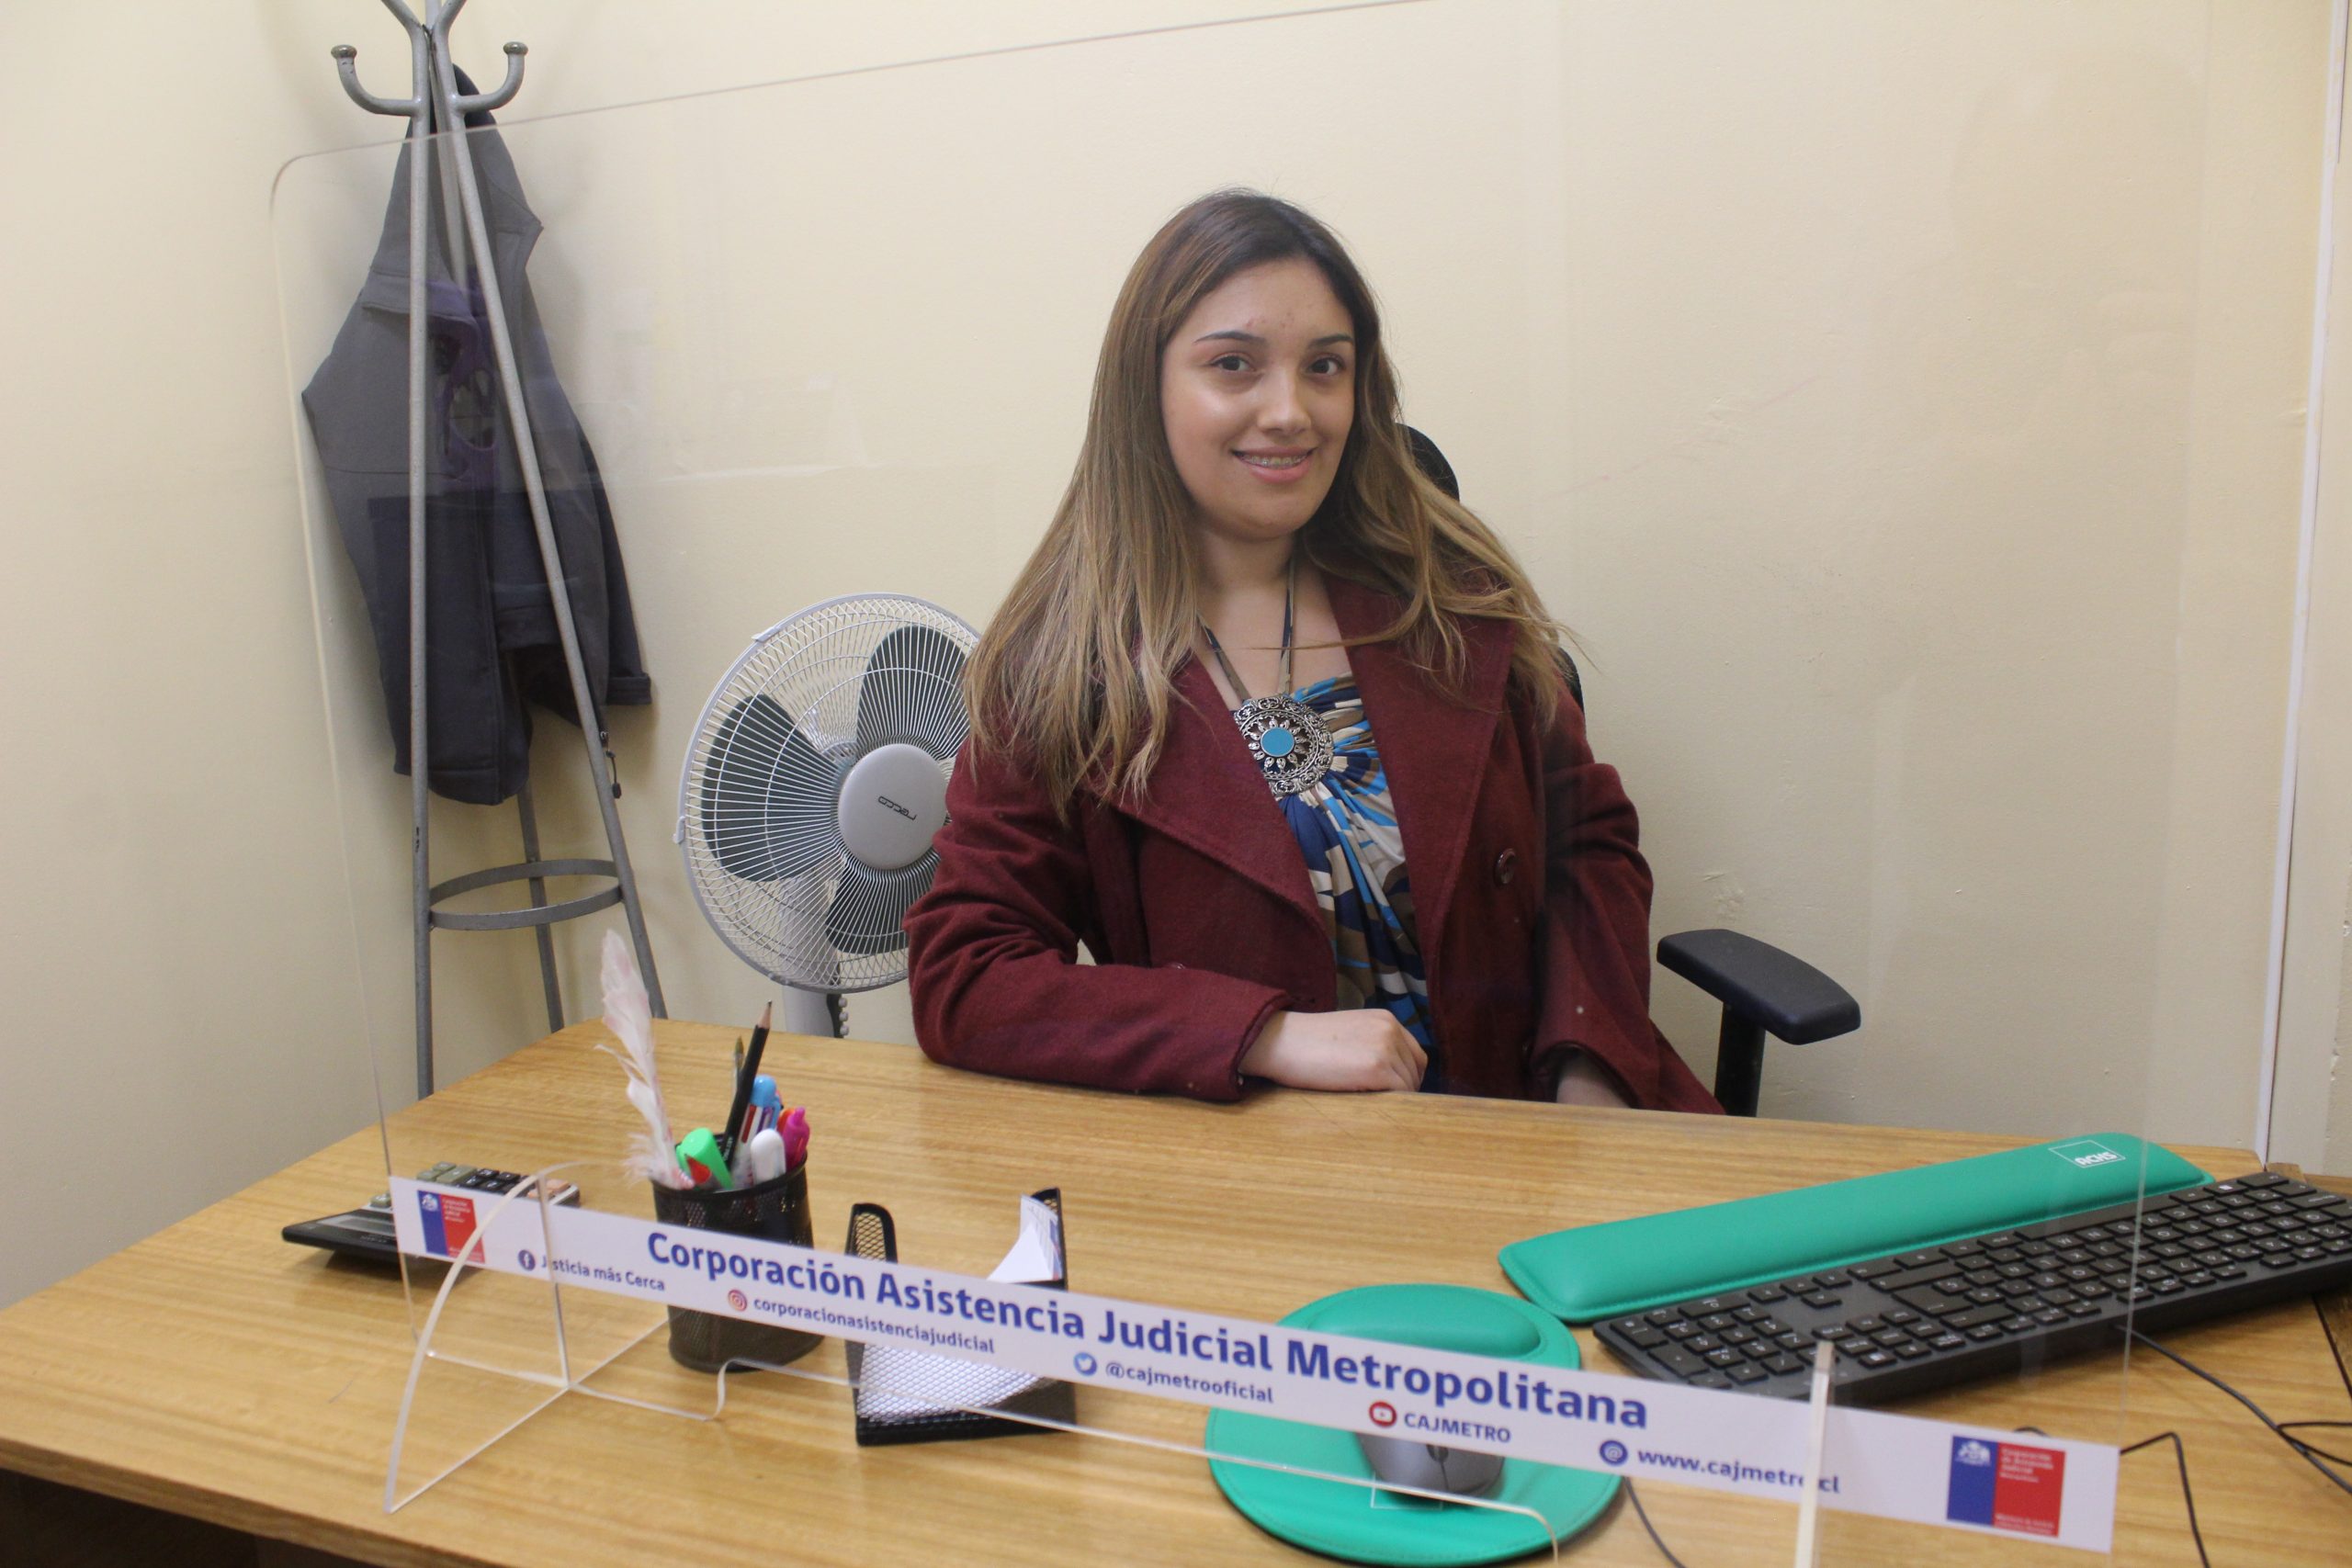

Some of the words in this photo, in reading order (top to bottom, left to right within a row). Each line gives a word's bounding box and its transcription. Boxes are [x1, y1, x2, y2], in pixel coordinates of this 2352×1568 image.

[540, 1254, 591, 1277] Jsticia
[594, 1268, 622, 1283] más
[625, 1270, 665, 1292] Cerca
[646, 1232, 866, 1302] Corporación
[875, 1272, 1087, 1341] Asistencia
[1097, 1310, 1274, 1374] Judicial
[1285, 1338, 1648, 1430] Metropolitana
[752, 1298, 996, 1355] corporacionasistenciajudicial
[1105, 1361, 1274, 1404] @cajmetrooficial
[1403, 1412, 1512, 1444] CAJMETRO
[1637, 1450, 1840, 1495] www.cajmetrcl
